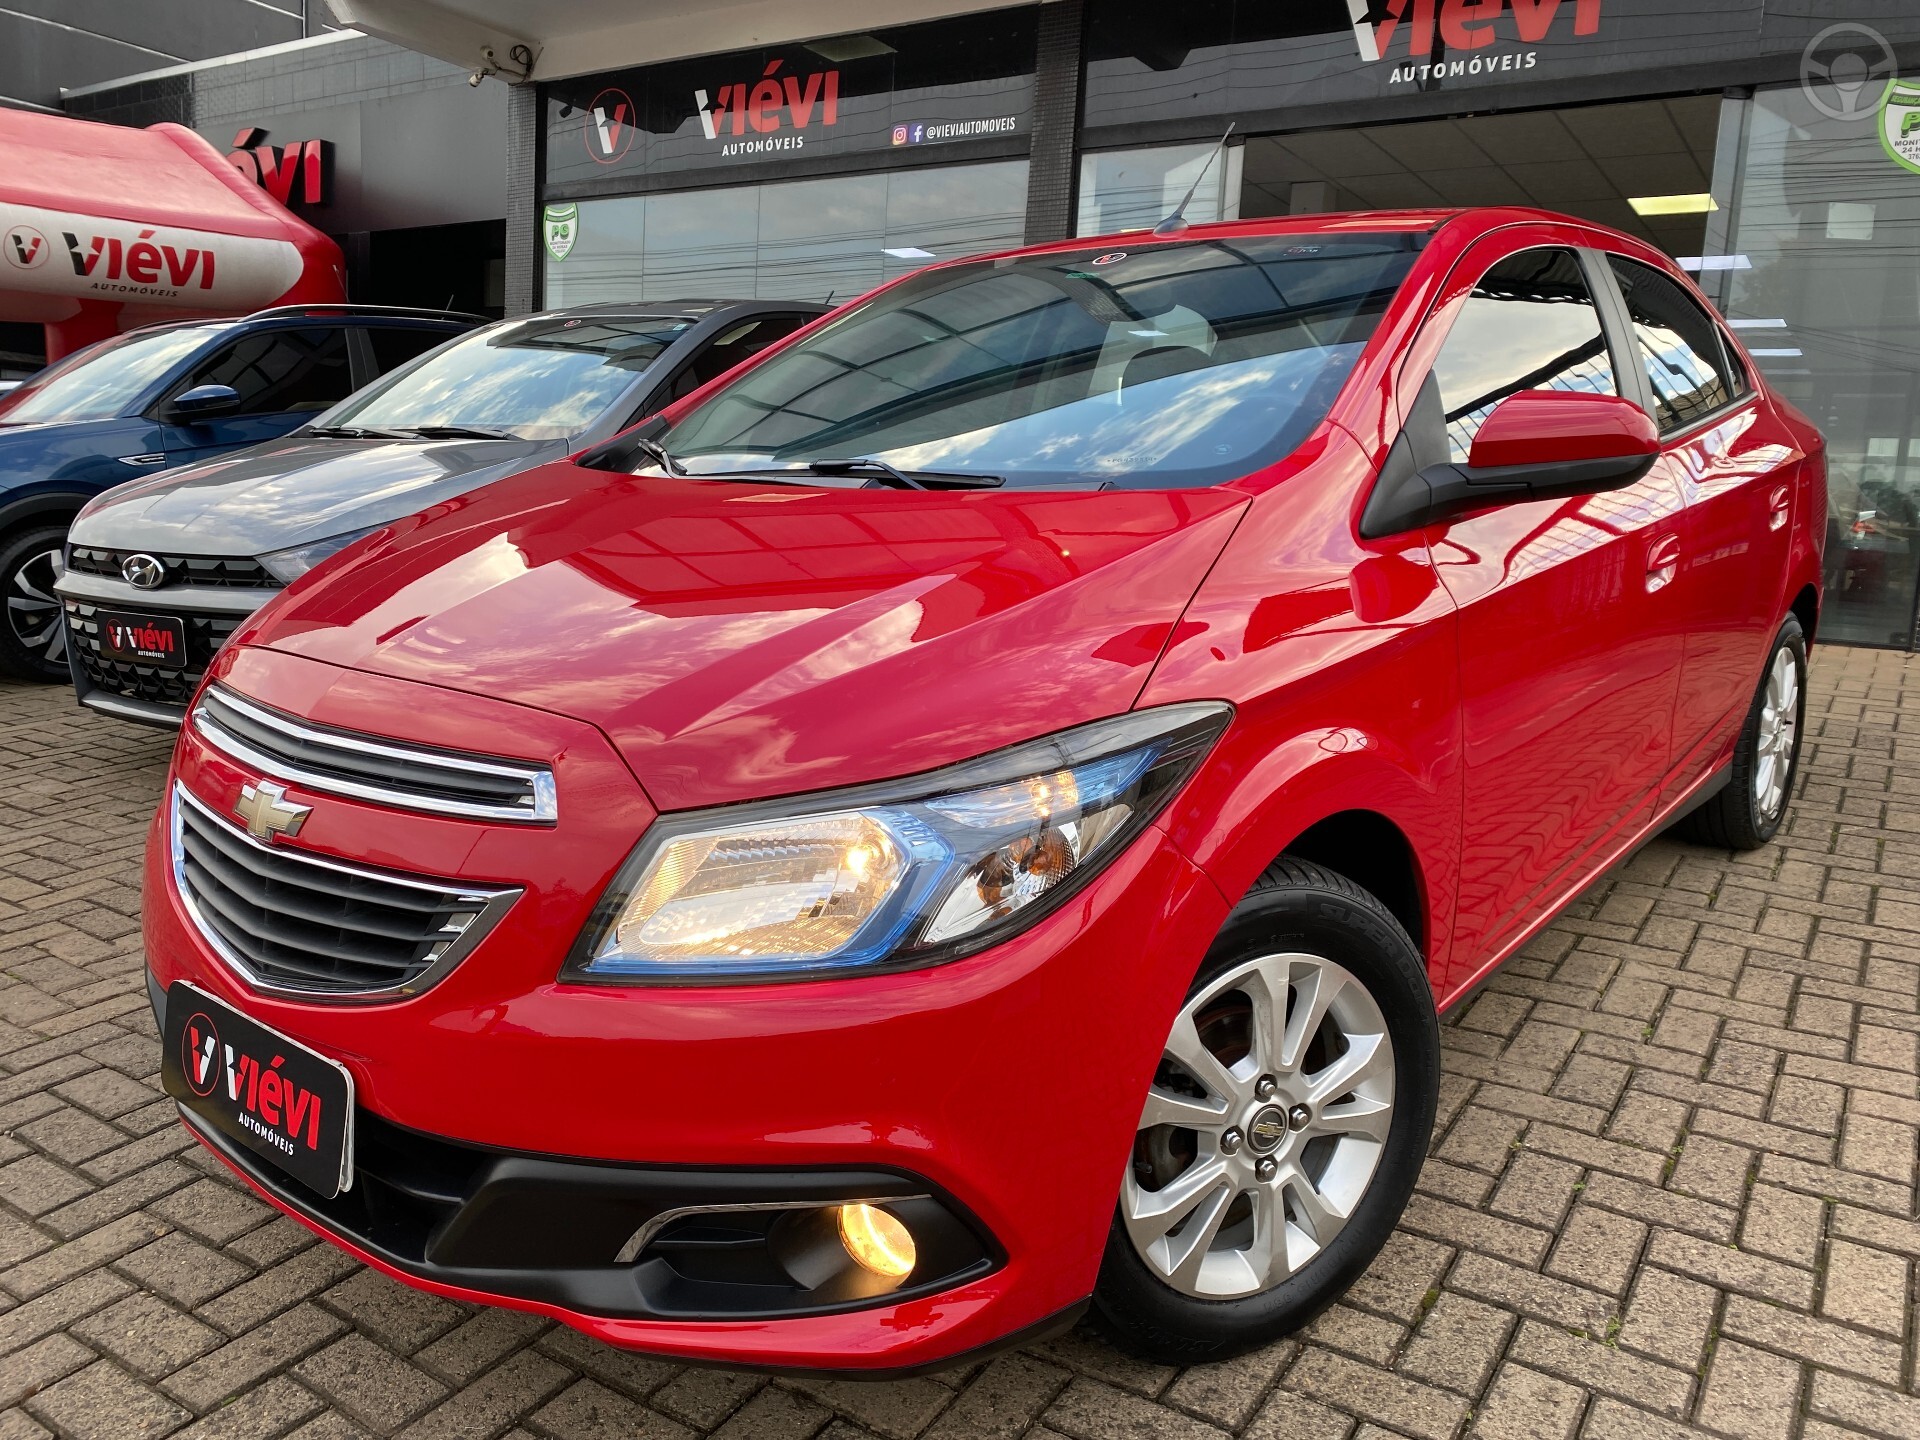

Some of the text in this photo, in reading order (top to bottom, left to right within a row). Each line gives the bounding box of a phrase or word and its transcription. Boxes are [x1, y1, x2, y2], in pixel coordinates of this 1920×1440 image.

[1388, 52, 1538, 84] AUTOMÓVEIS
[926, 116, 1017, 140] @VIEVIAUTOMOVEIS
[721, 135, 805, 157] AUTOMÓVEIS
[90, 281, 180, 299] AUTOMÓVEIS
[238, 1111, 295, 1157] AUTOMÓVEIS
